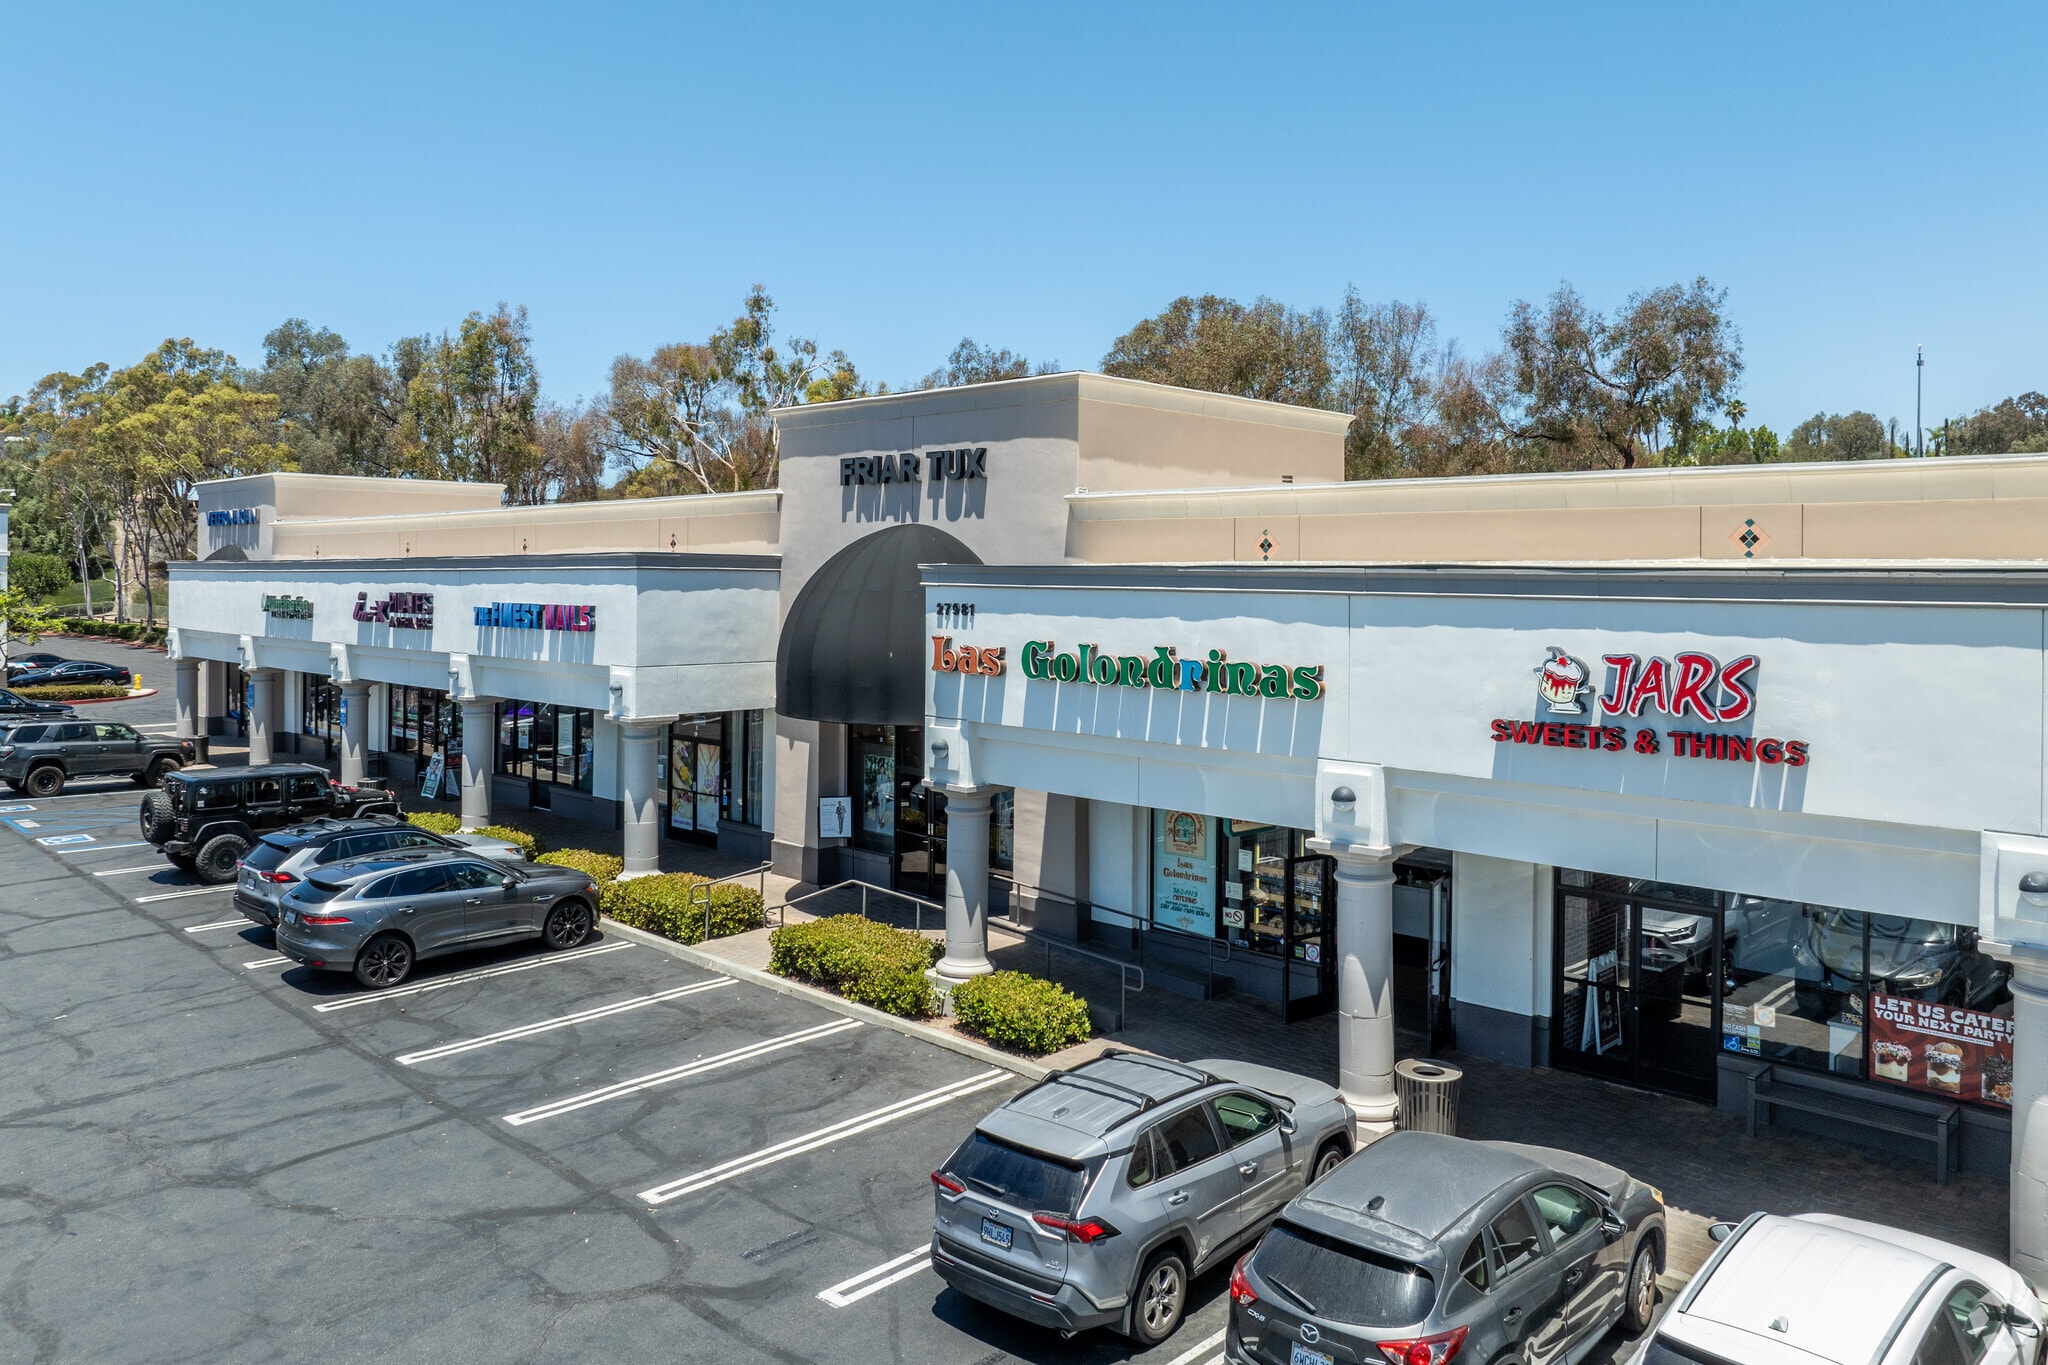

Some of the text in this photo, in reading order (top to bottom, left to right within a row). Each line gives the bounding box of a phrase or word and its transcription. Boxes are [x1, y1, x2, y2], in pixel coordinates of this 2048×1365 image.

[840, 448, 988, 486] FRIAR TUX
[389, 592, 434, 613] PILATES
[936, 602, 975, 616] 27981
[474, 602, 596, 632] THE FINEST NAILS
[931, 635, 1325, 701] Las Golondrinas
[1599, 651, 1760, 723] JARS
[1491, 719, 1809, 767] SWEETS & THINGS
[1163, 867, 1208, 883] Golondrinas
[1177, 858, 1193, 869] Las
[1224, 911, 1233, 919] NO
[1874, 995, 1912, 1013] LET
[1917, 1003, 1946, 1020] US
[1874, 1008, 1915, 1025] YOUR
[1918, 1017, 1960, 1033] NEXT
[1963, 1026, 2015, 1044] PARTY
[1247, 1303, 1266, 1322] CX-5
[1293, 1352, 1330, 1365] 6WCH
